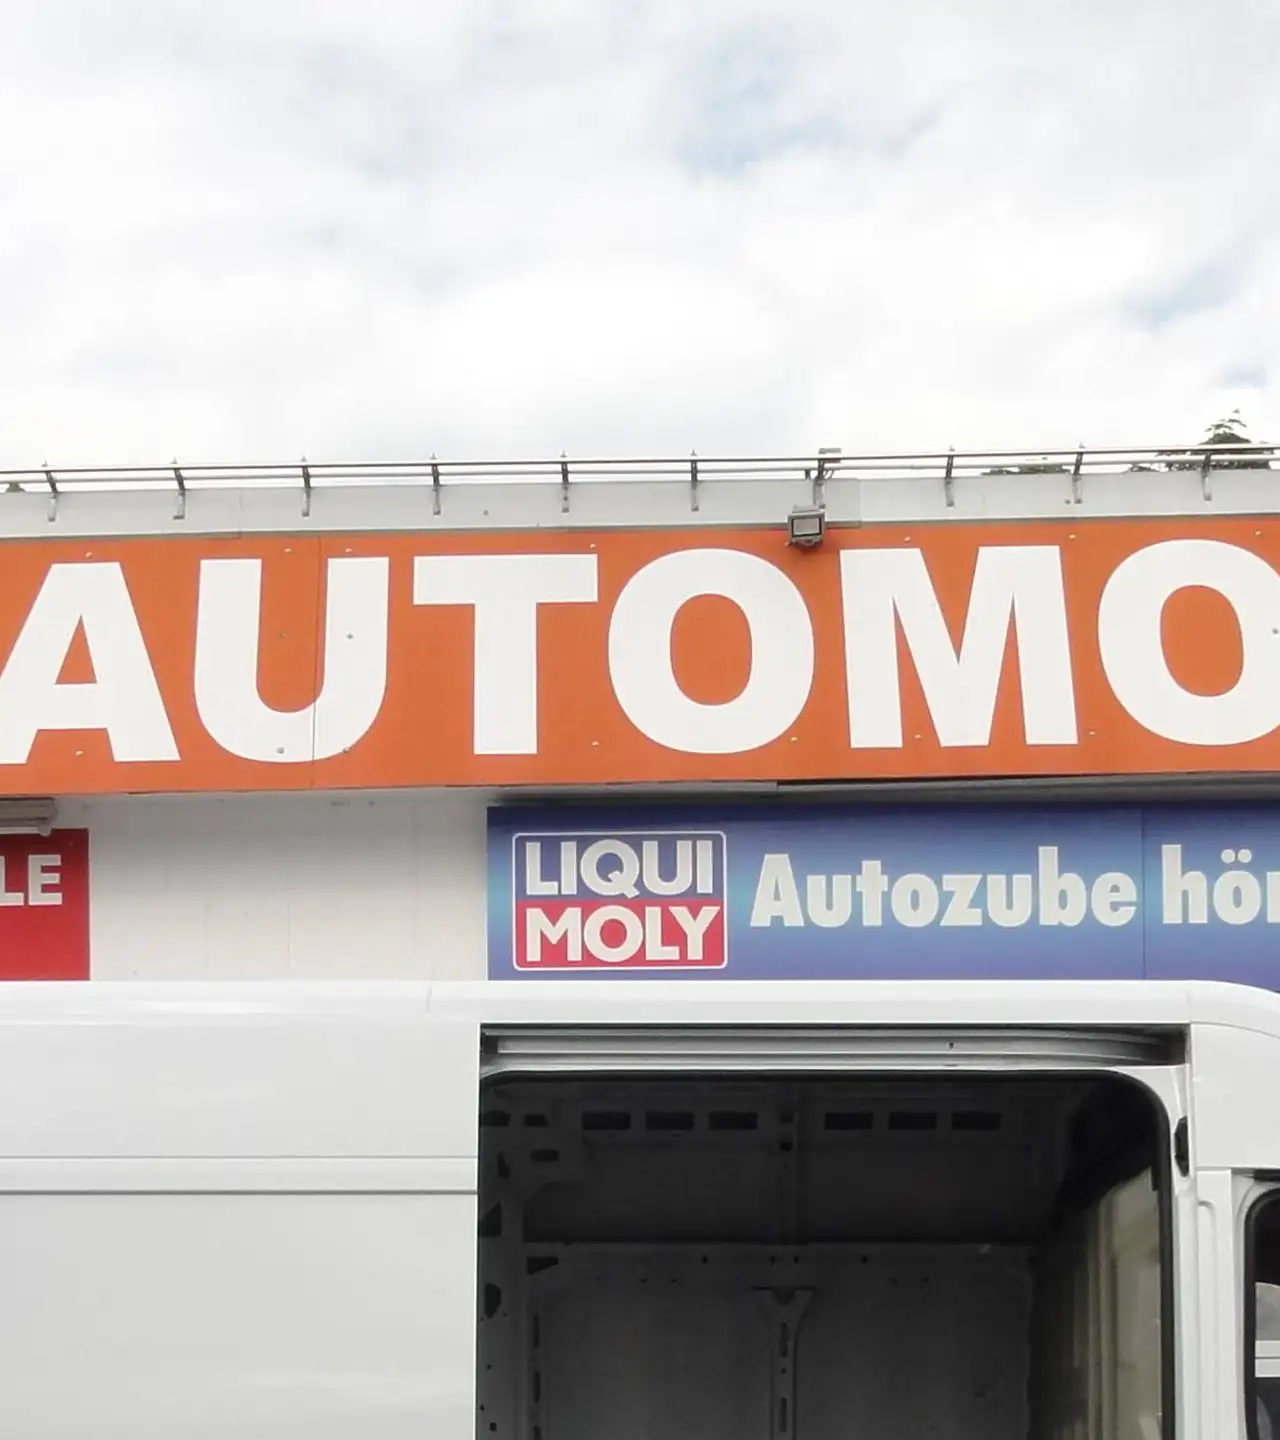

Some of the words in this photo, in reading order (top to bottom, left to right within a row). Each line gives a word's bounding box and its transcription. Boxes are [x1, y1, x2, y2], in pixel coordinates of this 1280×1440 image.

[524, 838, 713, 899] LIQUI
[749, 845, 1138, 928] Autozube
[524, 903, 721, 962] MOLY
